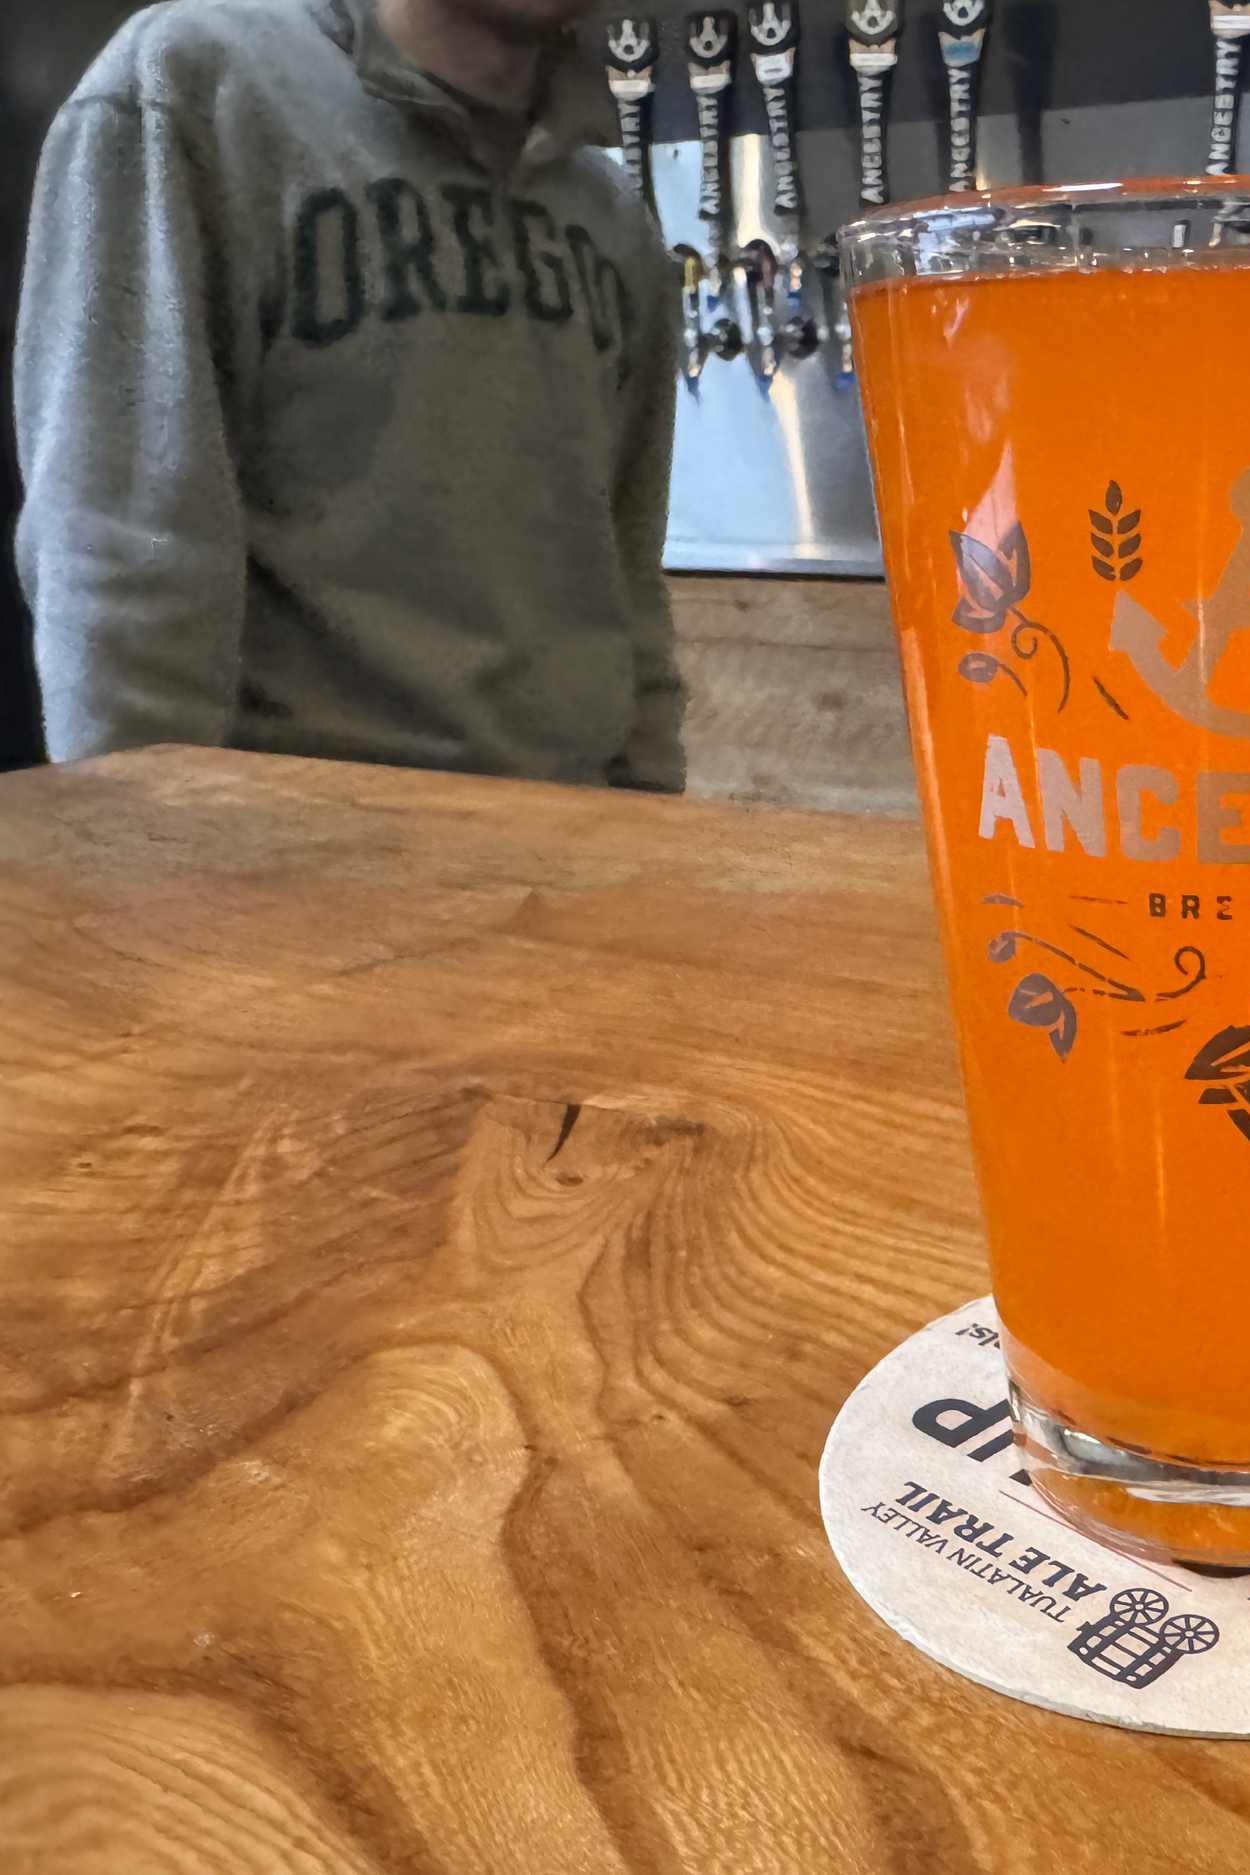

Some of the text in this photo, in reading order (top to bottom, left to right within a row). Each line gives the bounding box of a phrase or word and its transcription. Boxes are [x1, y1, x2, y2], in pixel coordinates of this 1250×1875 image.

[858, 77, 885, 203] ANCESTRY
[1206, 41, 1242, 175] ANCESTRY
[861, 1502, 1072, 1623] TUALATIN VALLEY
[895, 1481, 1107, 1602] ALE TRAIL
